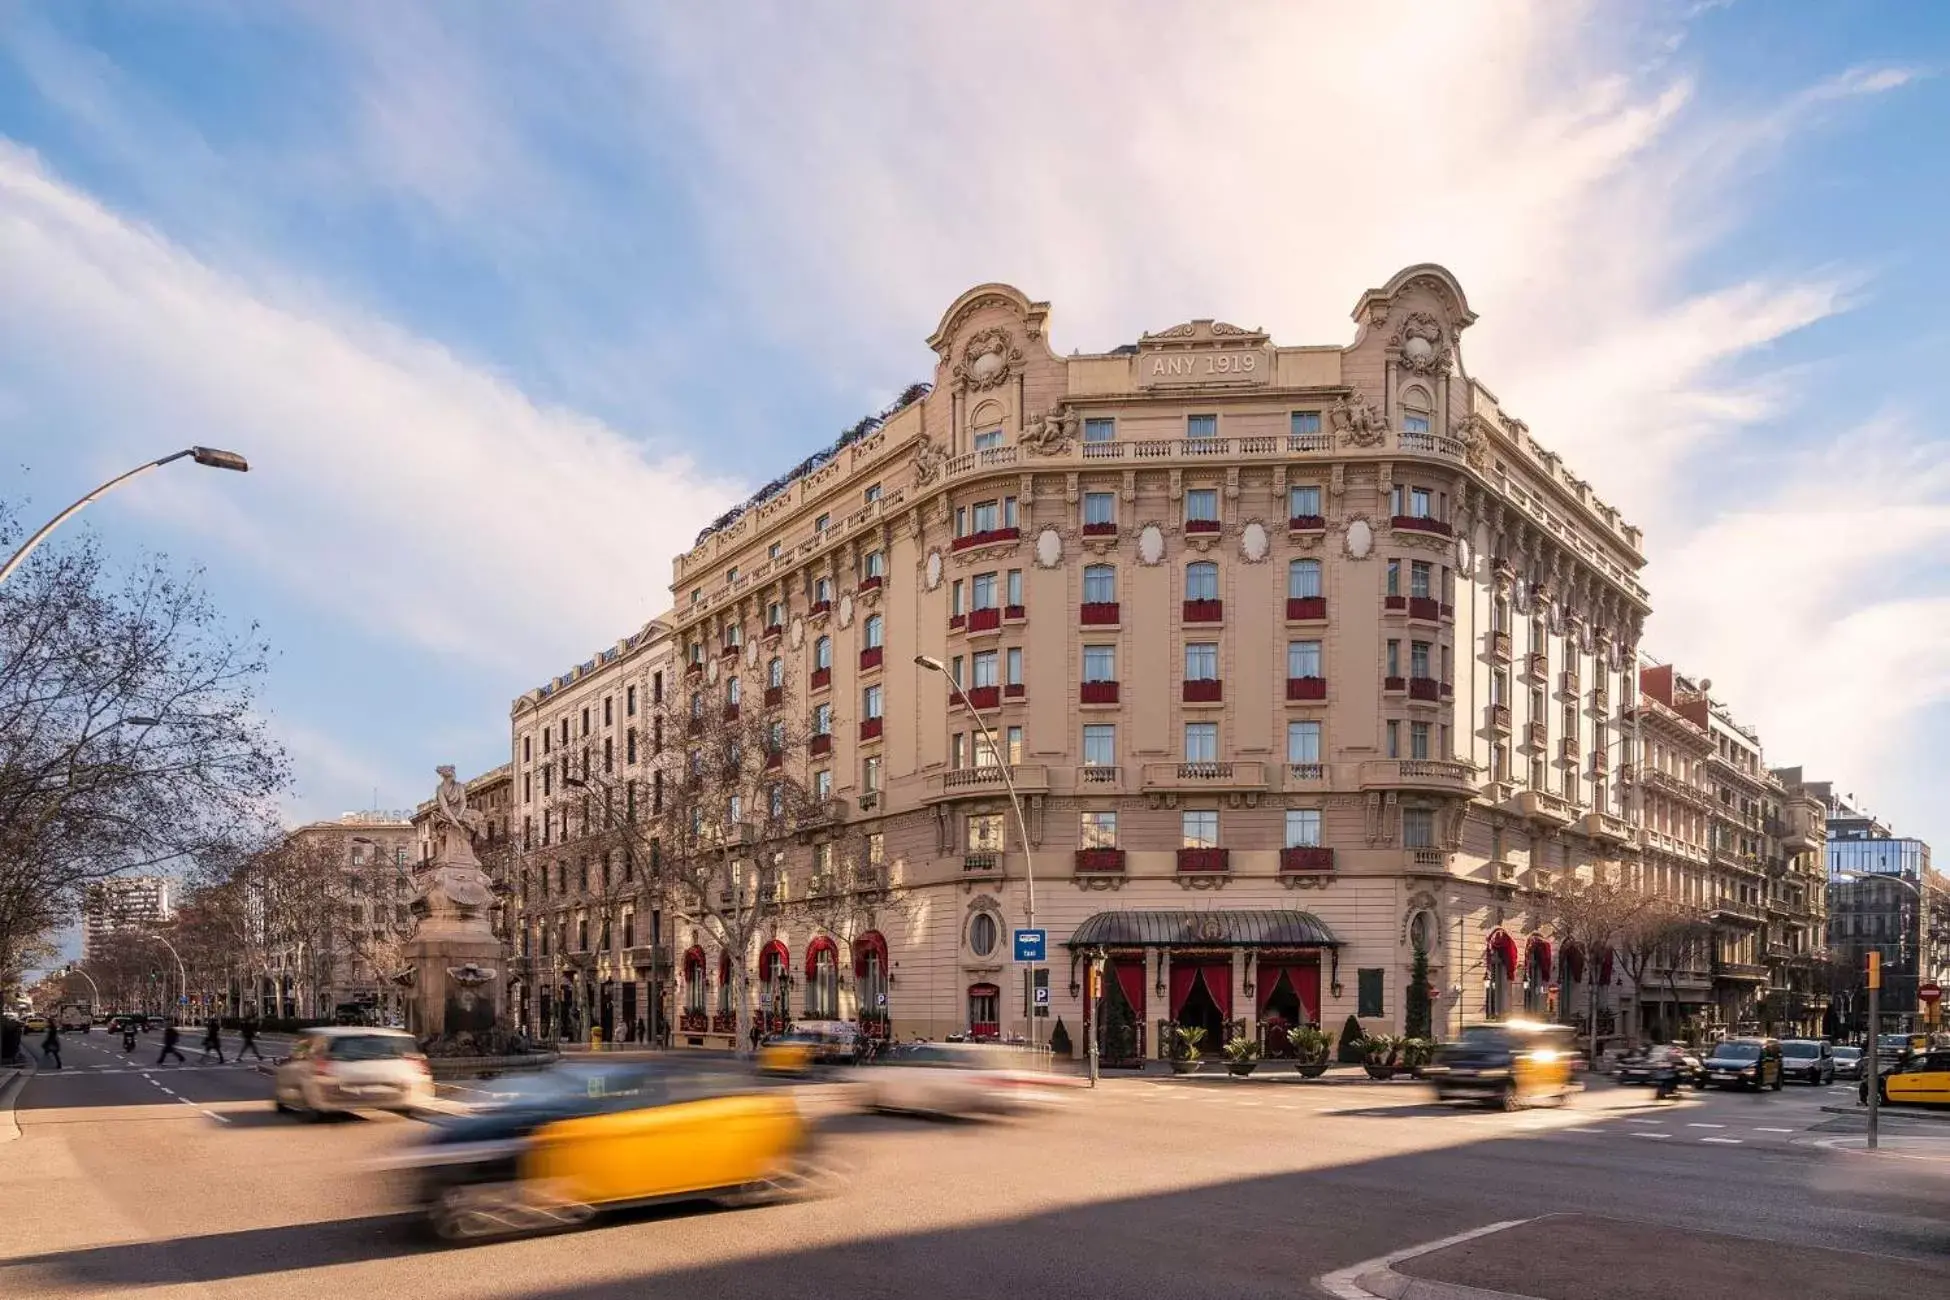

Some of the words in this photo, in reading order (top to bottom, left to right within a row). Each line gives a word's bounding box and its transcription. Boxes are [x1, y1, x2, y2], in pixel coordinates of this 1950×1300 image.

[1152, 357, 1196, 376] ANY
[1205, 354, 1256, 374] 1919
[878, 995, 885, 1005] P
[1036, 989, 1046, 1001] P
